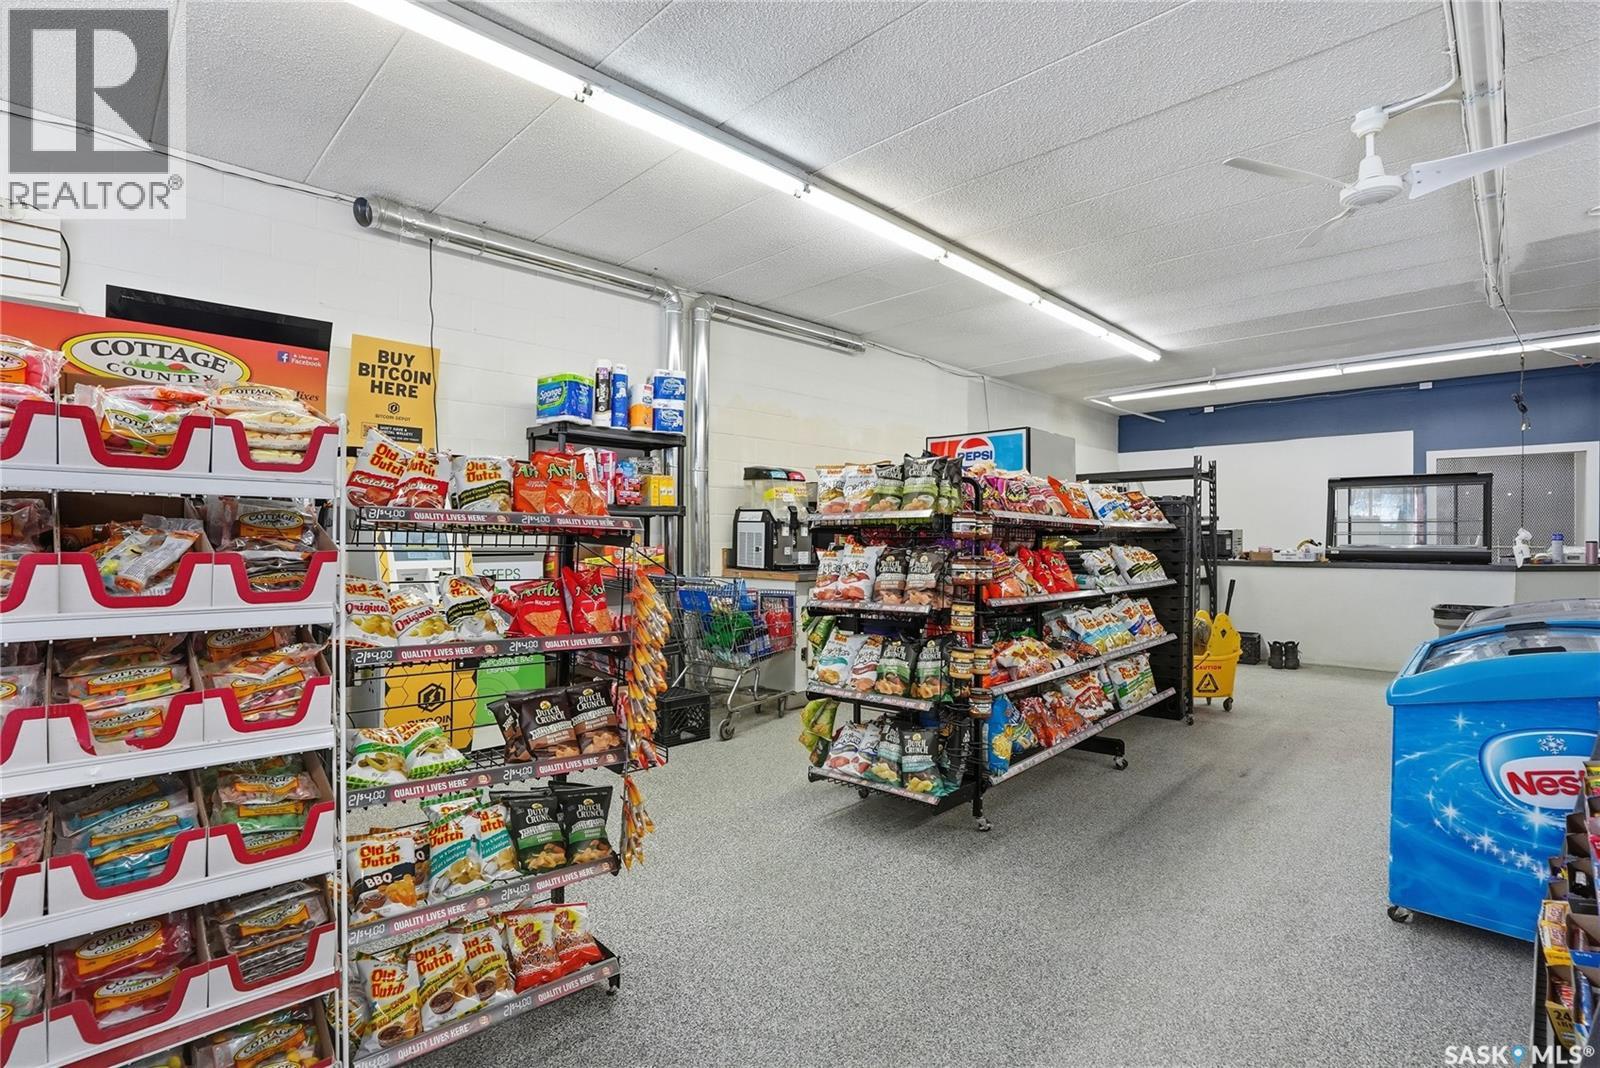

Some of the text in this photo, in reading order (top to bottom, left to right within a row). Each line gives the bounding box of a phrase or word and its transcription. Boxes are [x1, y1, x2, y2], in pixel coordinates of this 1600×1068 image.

[291, 358, 321, 368] Facebook
[378, 349, 415, 367] BUY
[107, 363, 214, 384] COUNTRY
[359, 362, 431, 385] BITCOIN
[371, 380, 418, 398] HERE
[376, 444, 399, 462] Old
[958, 451, 993, 461] PEPSI
[467, 470, 501, 483] Dutch
[249, 513, 295, 522] COTTAGE
[414, 512, 444, 521] QUALITY
[446, 514, 466, 522] LIVES
[545, 639, 569, 649] QUALITY
[571, 638, 587, 647] LIVES
[401, 648, 432, 660] QUALITY
[434, 647, 454, 657] LIVES
[577, 698, 606, 711] CRUNCH
[579, 692, 601, 704] DUTCH
[535, 705, 561, 717] DUTCH
[535, 710, 566, 724] CRUNCH
[904, 746, 929, 755] CRUNCH
[907, 739, 926, 748] DUTCH
[539, 762, 565, 774] QUALITY
[565, 760, 582, 771] LIVES
[348, 789, 386, 806] 2/$4.00
[394, 785, 424, 798] QUALITY
[427, 782, 447, 793] LIVES
[360, 844, 384, 857] Old
[360, 853, 400, 869] Dutch
[364, 872, 392, 889] BBQ
[536, 877, 561, 890] QUALITY
[562, 872, 578, 883] LIVES
[394, 915, 424, 931] QUALITY
[426, 909, 447, 922] LIVES
[87, 925, 150, 951] COTTAGE
[348, 924, 386, 944] 2/$4.00
[416, 947, 437, 963] Old
[417, 951, 454, 975] Dutch
[371, 968, 396, 982] Old
[371, 982, 405, 999] Dutch
[538, 987, 563, 1003] QUALITY
[563, 981, 579, 994] LIVES
[397, 1041, 428, 1059] QUALITY
[429, 1032, 449, 1047] LIVES
